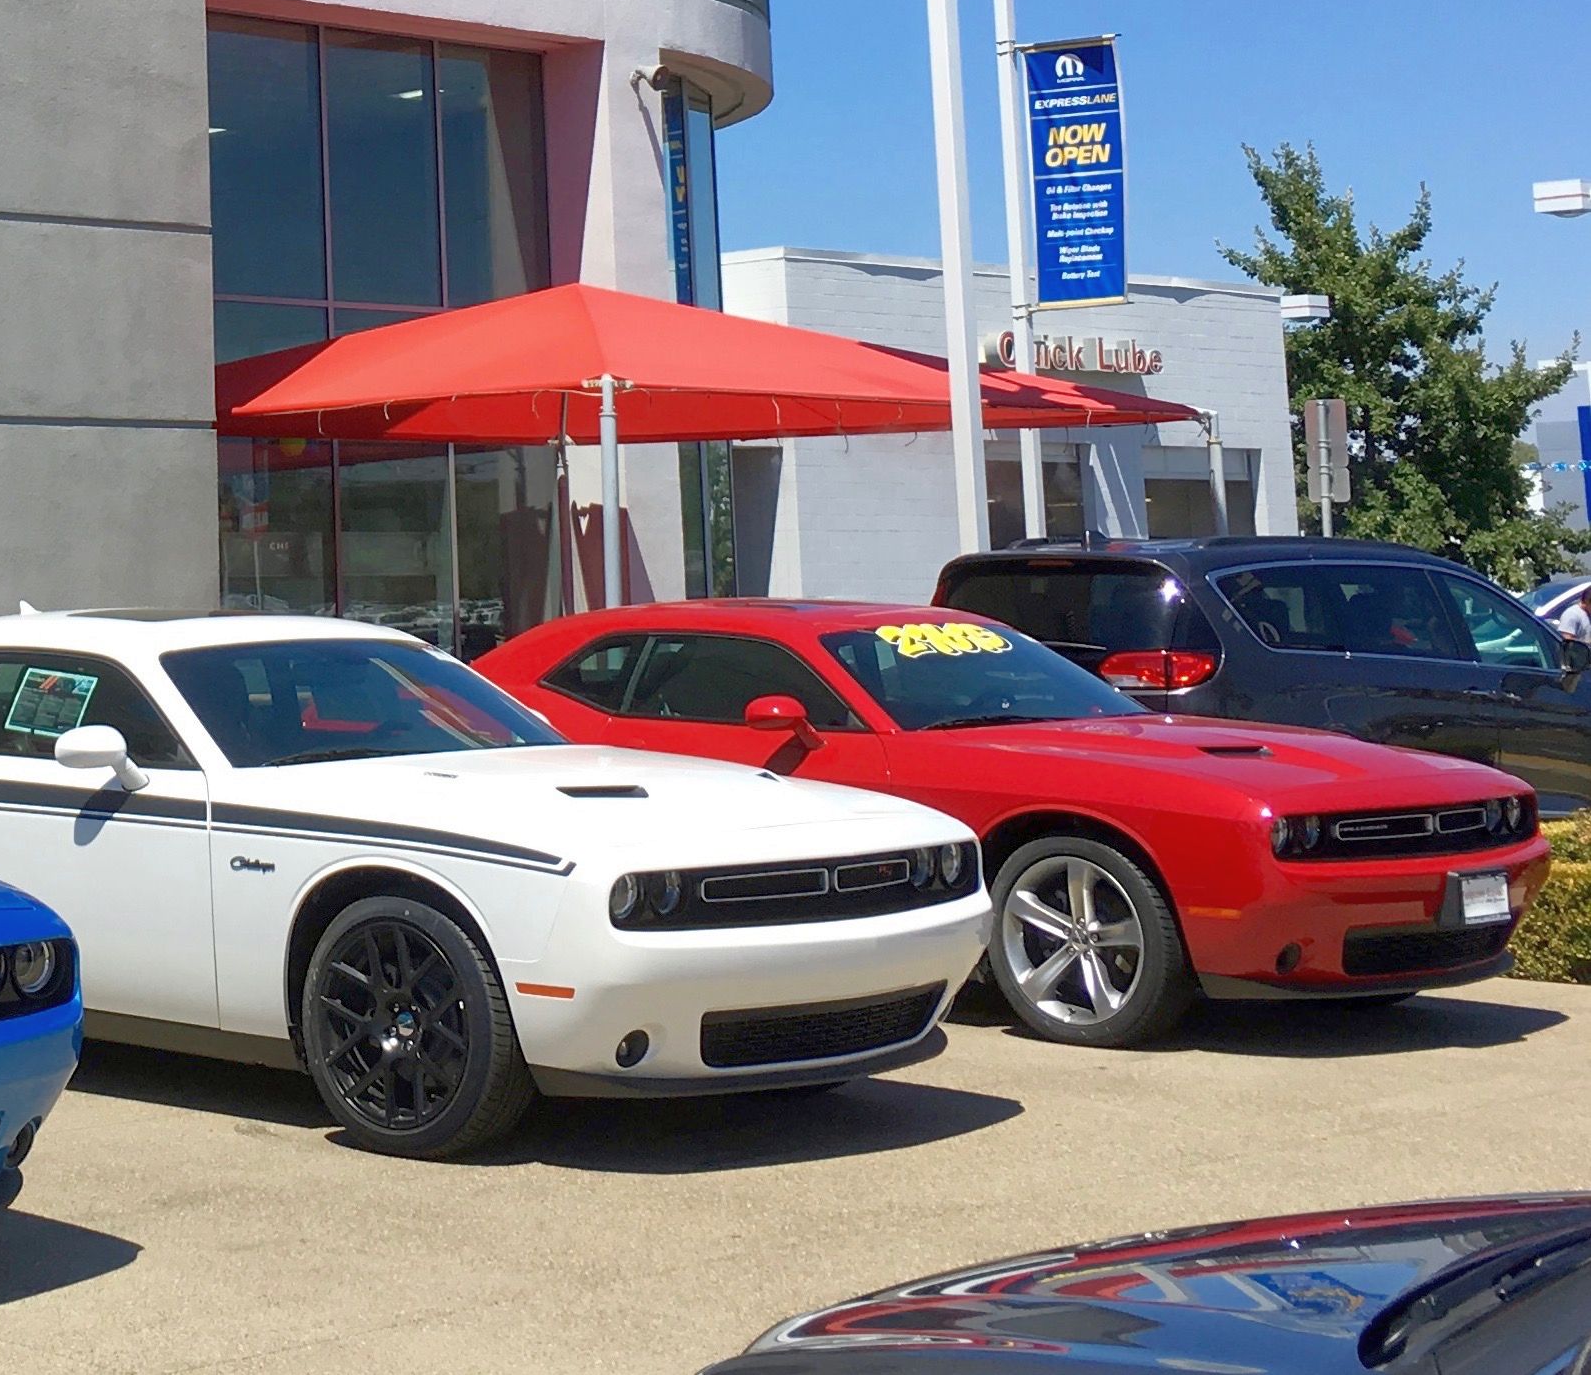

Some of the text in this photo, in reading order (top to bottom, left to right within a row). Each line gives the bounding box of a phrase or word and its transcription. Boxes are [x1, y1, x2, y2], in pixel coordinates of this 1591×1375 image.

[1034, 93, 1117, 110] EXPRESSLANE
[1048, 122, 1107, 146] NOW
[1045, 144, 1111, 167] OPEN
[1082, 183, 1112, 192] Changes
[1096, 336, 1164, 374] Lube
